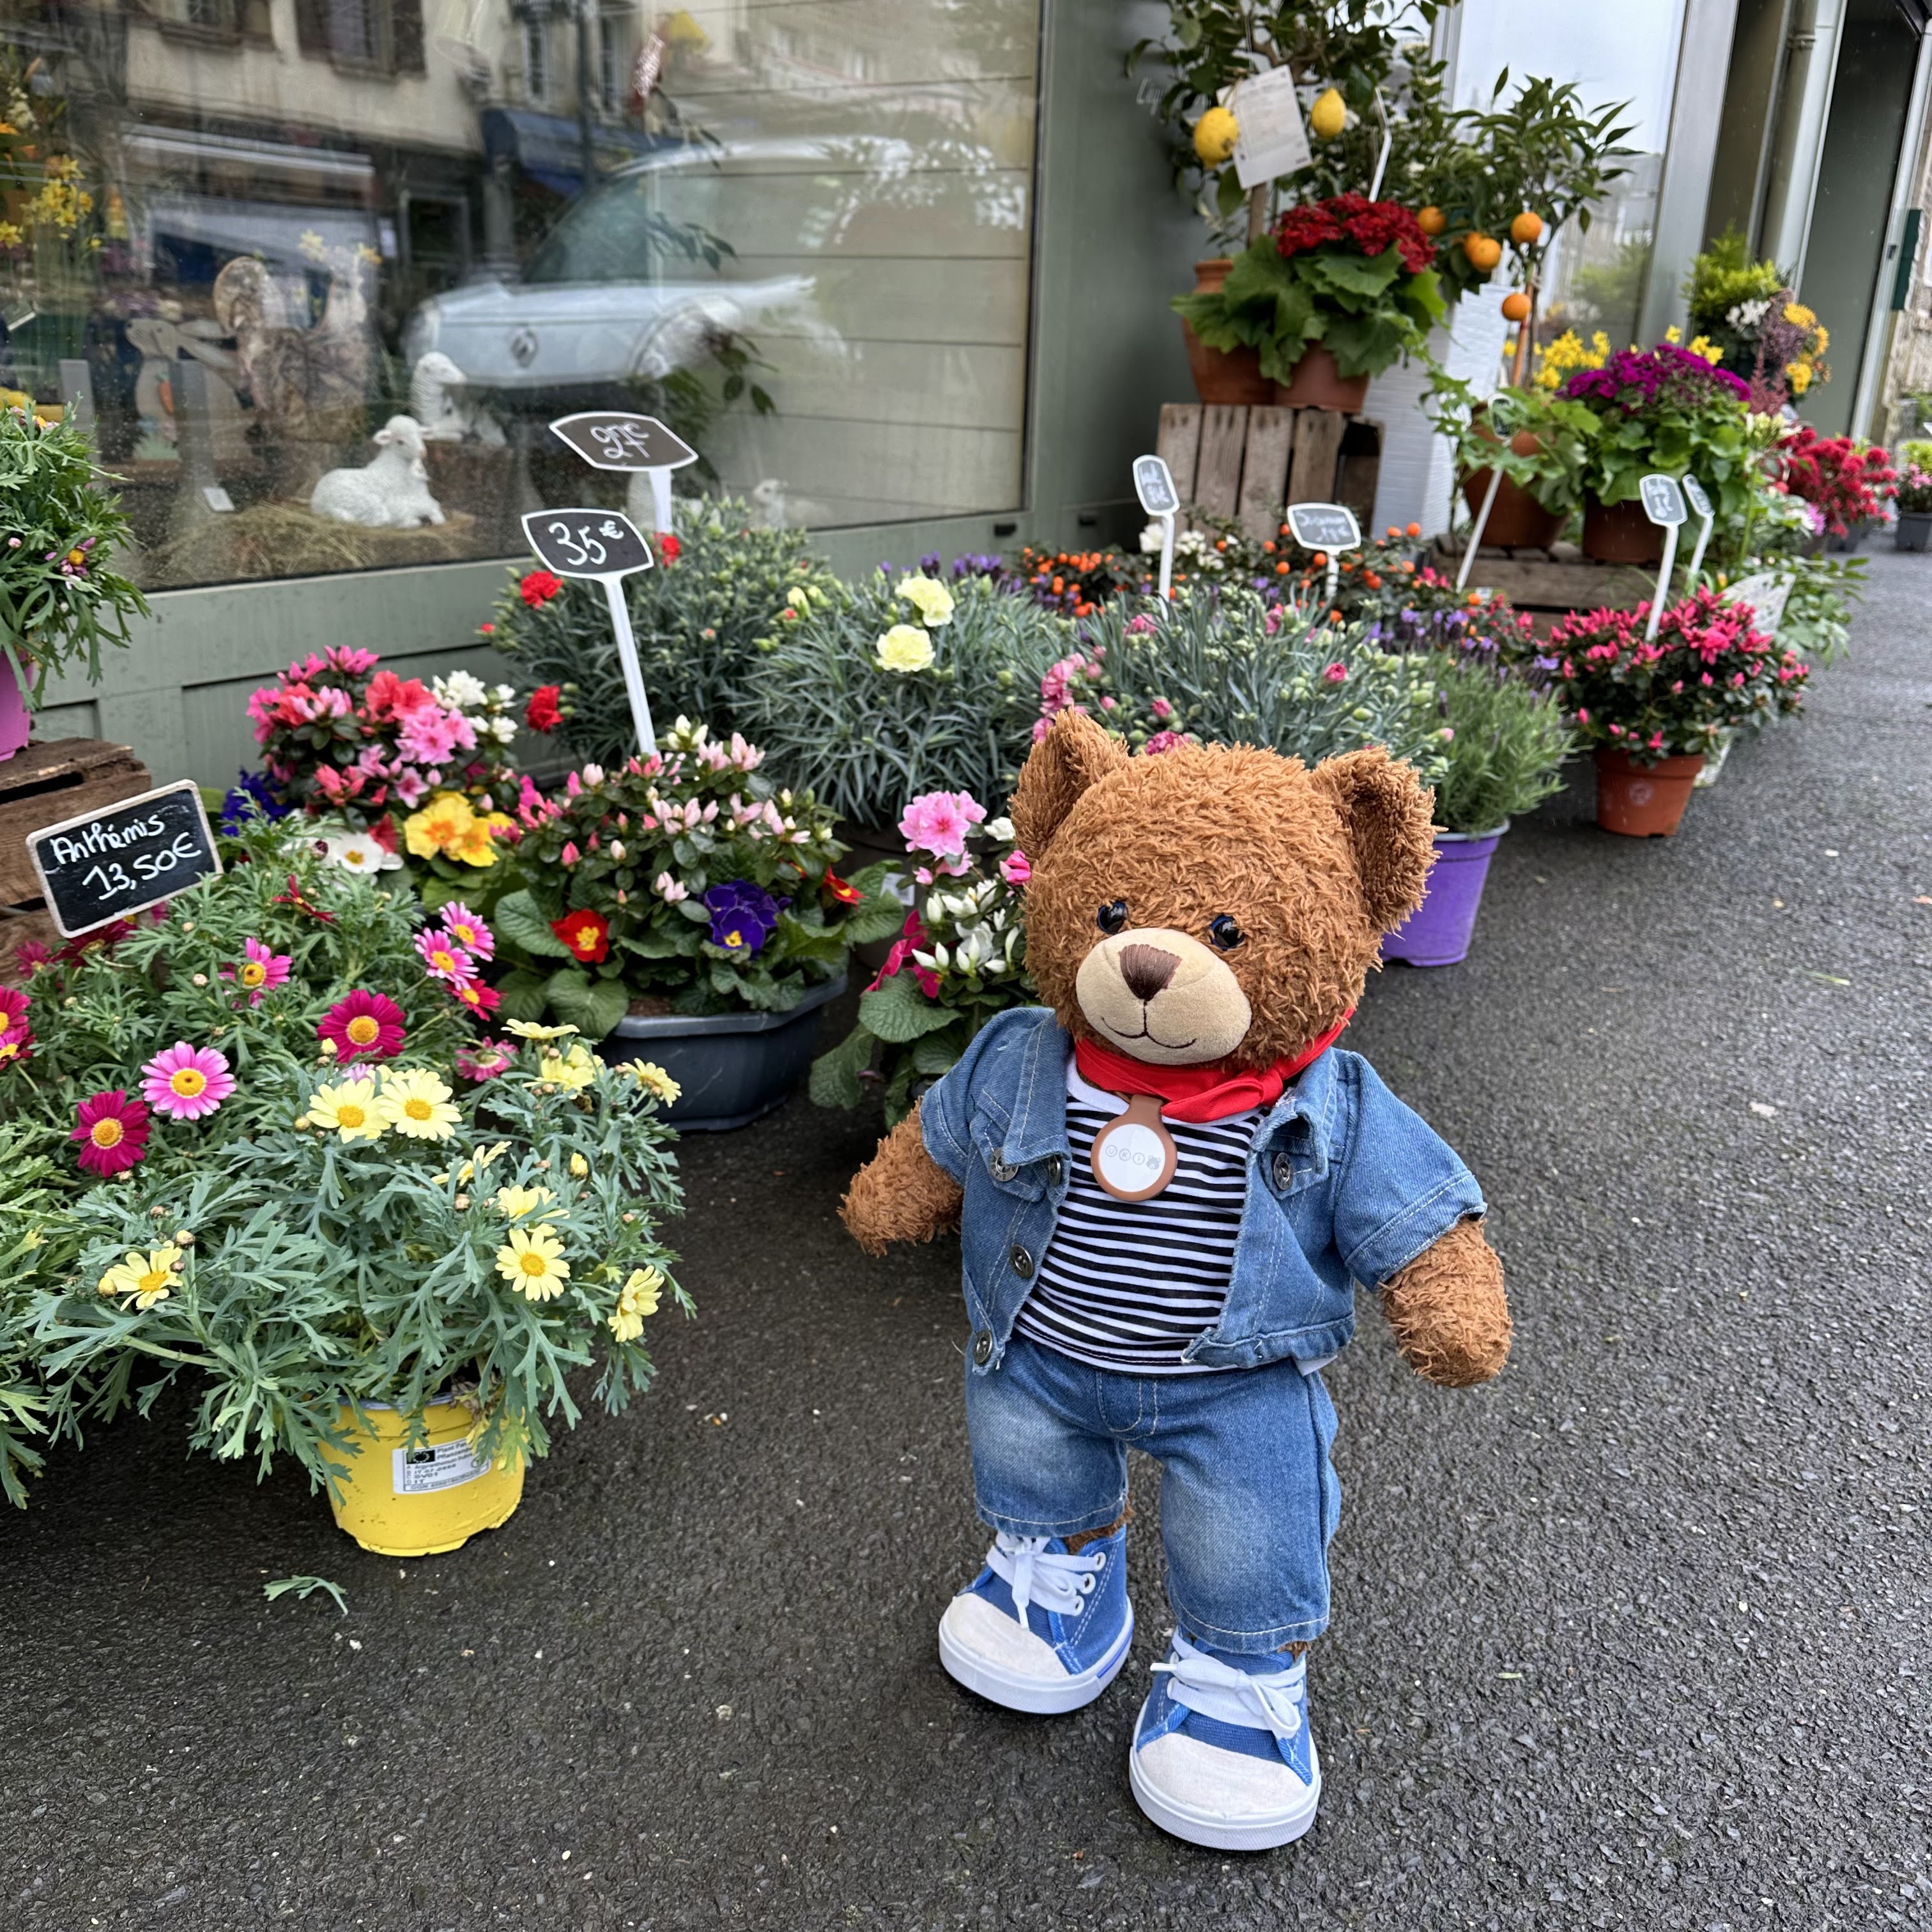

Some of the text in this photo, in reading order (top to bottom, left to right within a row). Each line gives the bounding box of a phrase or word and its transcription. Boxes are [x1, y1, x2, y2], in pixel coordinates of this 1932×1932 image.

[548, 519, 624, 566] 35€
[50, 814, 165, 865] Anthémis
[82, 831, 202, 901] 13,50€
